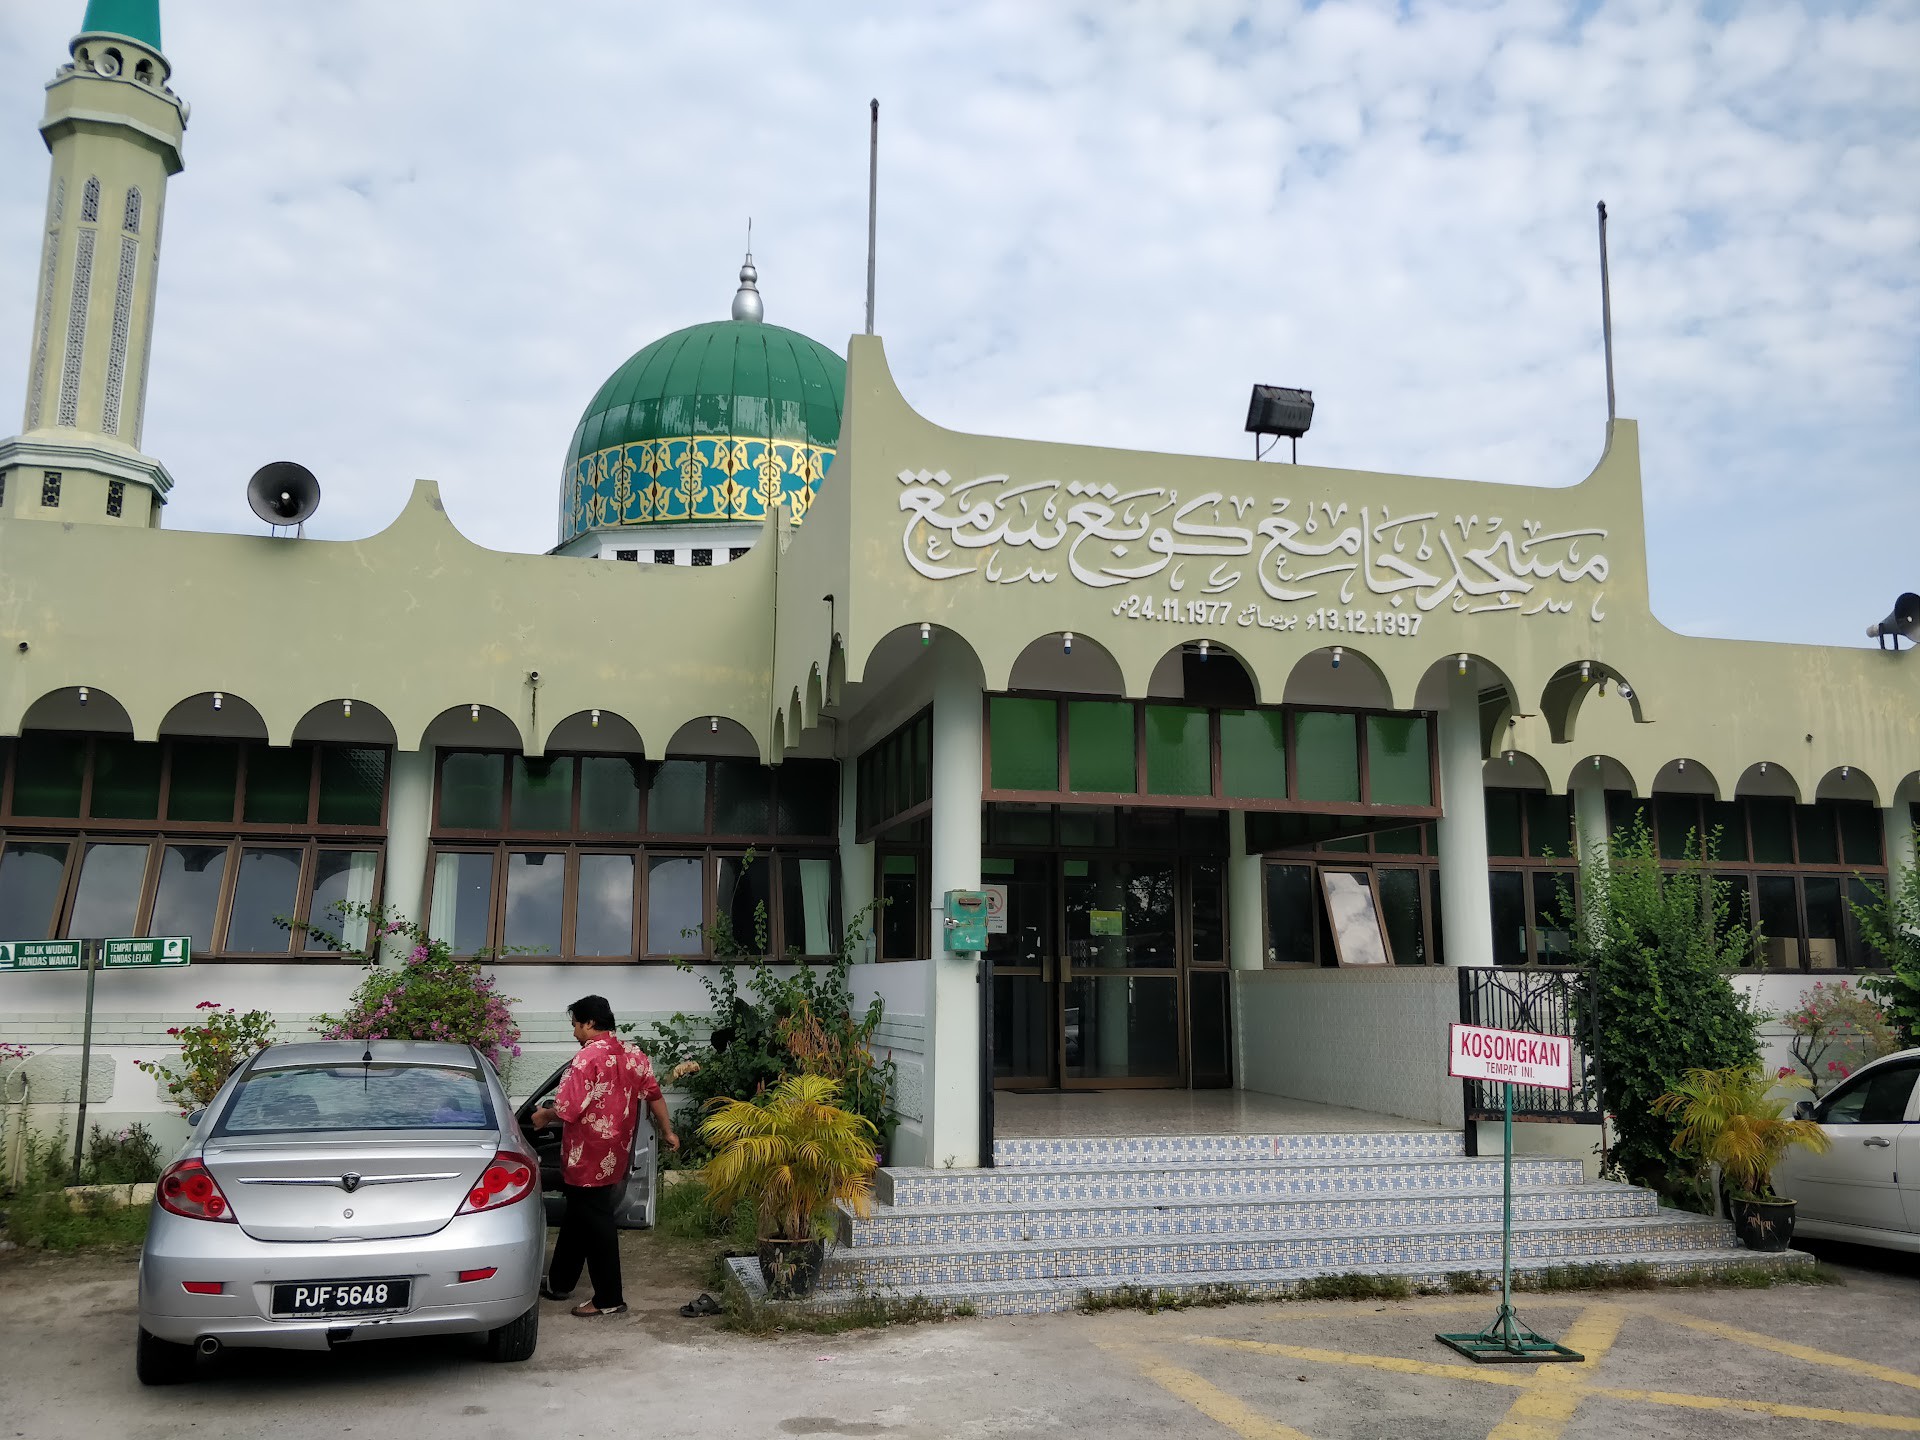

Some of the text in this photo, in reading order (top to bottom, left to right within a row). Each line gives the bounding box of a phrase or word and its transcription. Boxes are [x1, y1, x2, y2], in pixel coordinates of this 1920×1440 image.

[24, 944, 73, 955] BILIK WUDHU
[110, 942, 154, 953] TEMPAT WUDHU
[18, 955, 77, 966] TANDAS WANITA
[109, 953, 152, 963] TANDAS LELAKI
[1461, 1031, 1560, 1067] KOSONGKAN
[1485, 1061, 1535, 1078] TEMPAT INI.
[295, 1284, 389, 1307] PJF 5648
